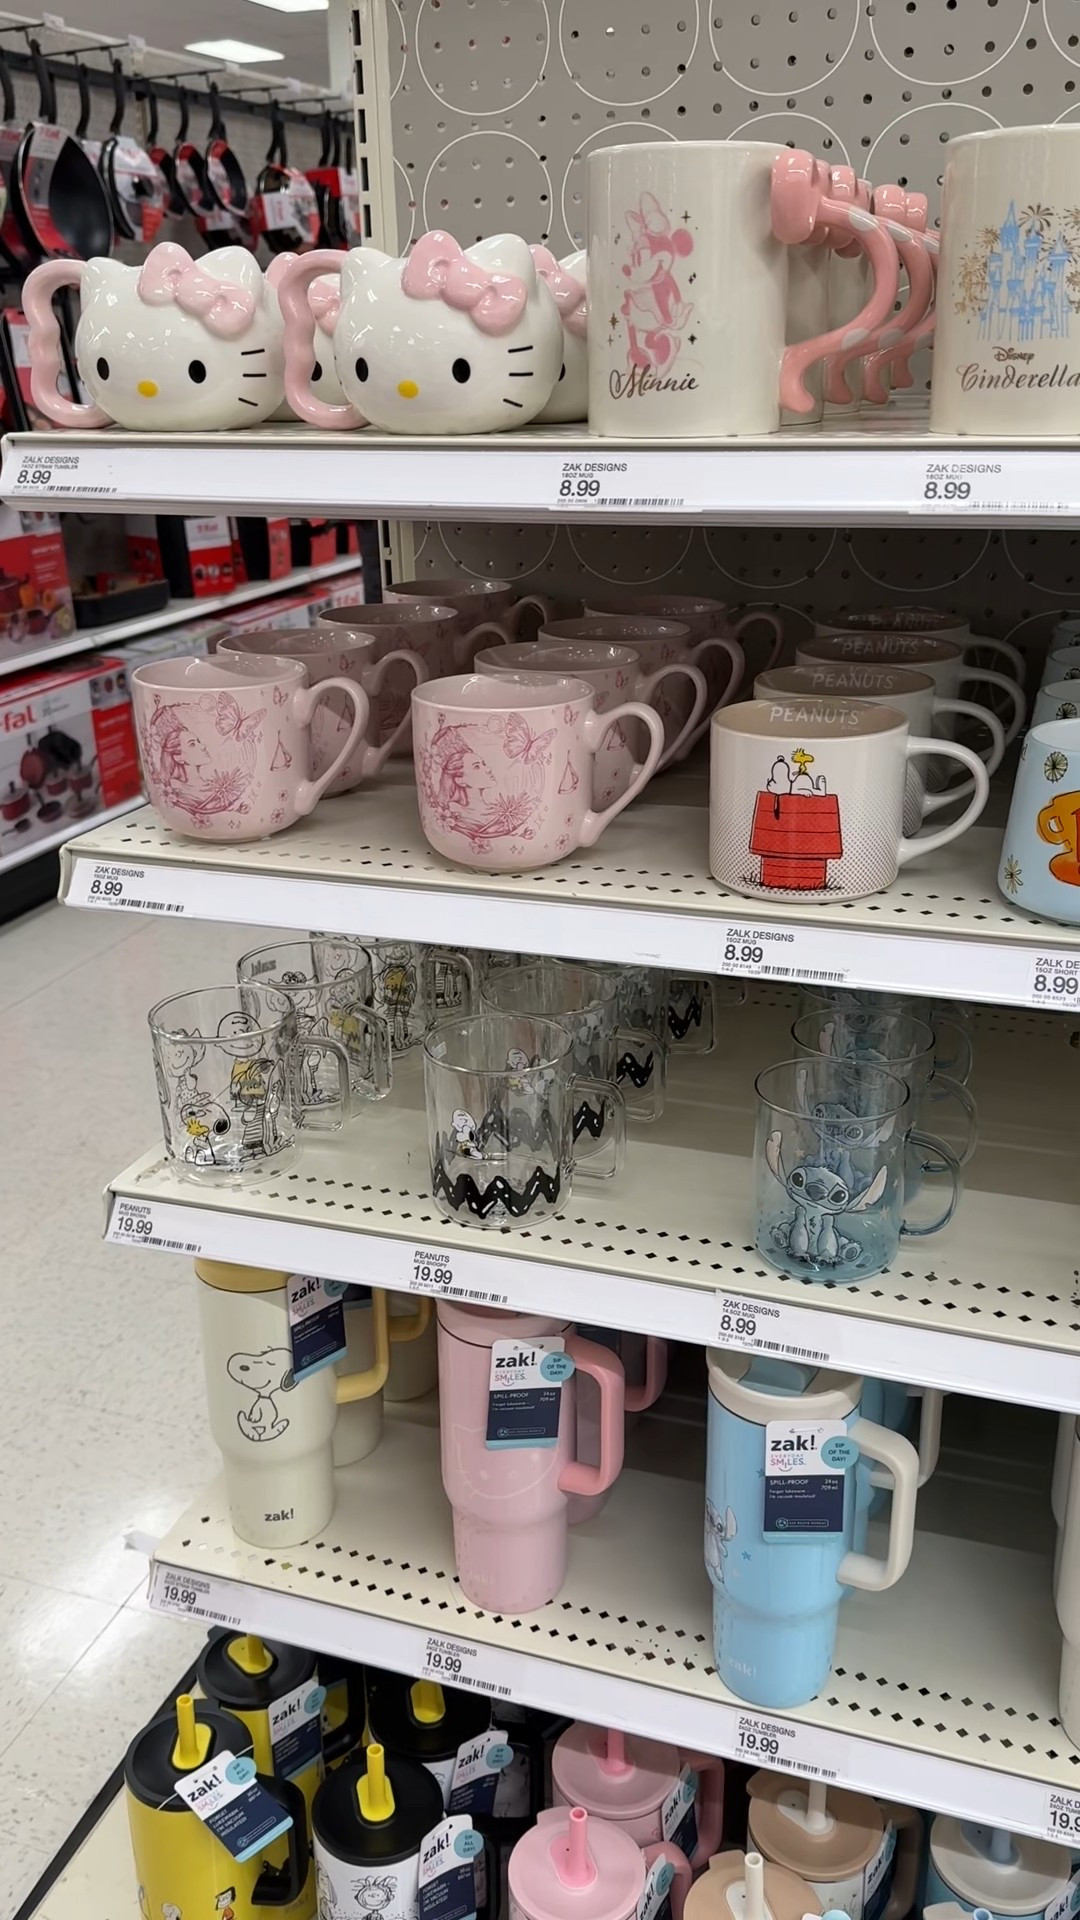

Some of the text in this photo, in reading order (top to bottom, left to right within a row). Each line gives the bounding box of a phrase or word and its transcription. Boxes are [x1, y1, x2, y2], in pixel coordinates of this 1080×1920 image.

[609, 363, 699, 399] Minnie
[563, 463, 628, 472] ZAK DESIGNS
[926, 464, 1002, 473] ZAK DESIGNS
[17, 470, 51, 484] 8.99
[560, 480, 600, 496] 8.99
[924, 482, 971, 499] 8.99
[842, 640, 918, 654] PEANUTS
[812, 674, 894, 689] PEANUTS
[770, 706, 860, 725] PEANUTS
[95, 866, 145, 878] ZAK DESIGNS
[91, 880, 123, 896] 8.99
[727, 929, 794, 942] ZALK DESIGNS
[724, 944, 763, 963] 8.99
[1036, 958, 1063, 968] ZALK
[1034, 974, 1078, 994] 8.99
[120, 1203, 151, 1214] PEANUTS
[118, 1216, 153, 1235] 19.99
[415, 1251, 450, 1263] PEANUTS
[414, 1265, 452, 1284] 19.99
[291, 1277, 321, 1303] zak!
[723, 1299, 780, 1318] ZAK DESIGNS
[721, 1315, 756, 1336] 8.99
[495, 1352, 535, 1368] zak!
[771, 1435, 815, 1451] zak!
[771, 1458, 804, 1468] SMILES
[264, 1508, 294, 1521] zak!
[183, 1576, 210, 1589] DESIGNS
[165, 1586, 196, 1605] 19.99
[428, 1638, 477, 1656] ZALK DESIGNS
[439, 1648, 460, 1657] TUMBLER
[426, 1652, 462, 1673] 19.99
[273, 1698, 301, 1725] zak!
[739, 1717, 796, 1738] ZALK DESIGNS
[752, 1728, 776, 1738] TUMBLER
[739, 1732, 779, 1754] 19.99
[458, 1745, 484, 1768] zak!
[187, 1774, 222, 1802] zak!
[665, 1789, 681, 1826] zak!
[1050, 1794, 1073, 1807] ZALK
[423, 1833, 450, 1864] zak!
[868, 1850, 884, 1884] zak!
